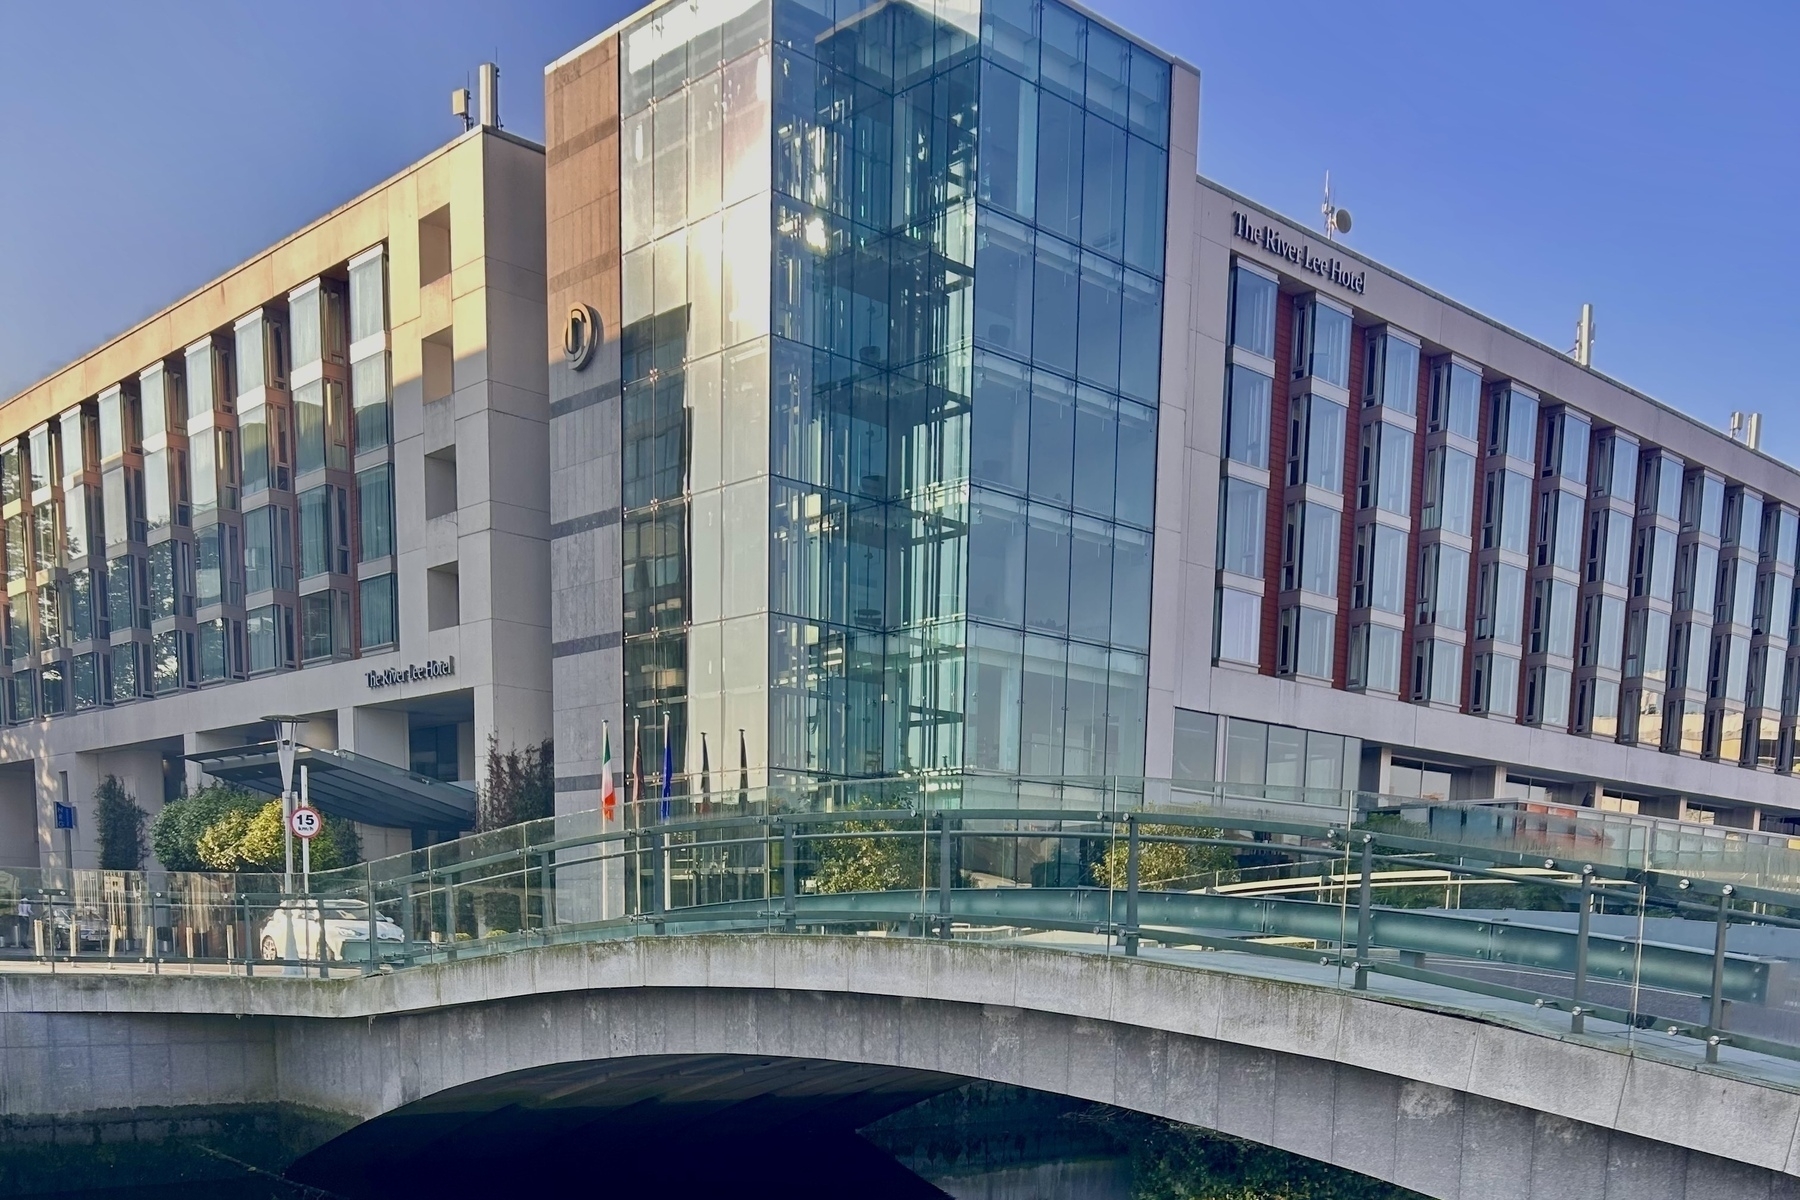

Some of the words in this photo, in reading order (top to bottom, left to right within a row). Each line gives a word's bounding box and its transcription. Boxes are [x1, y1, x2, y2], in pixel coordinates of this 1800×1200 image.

[1232, 211, 1263, 245] The
[1265, 226, 1302, 265] River
[1304, 246, 1329, 275] Lee
[1330, 258, 1367, 295] Hotel
[365, 670, 383, 689] The
[383, 667, 408, 686] River
[409, 664, 426, 681] Lee
[426, 655, 455, 679] Hotel
[296, 815, 314, 825] 15
